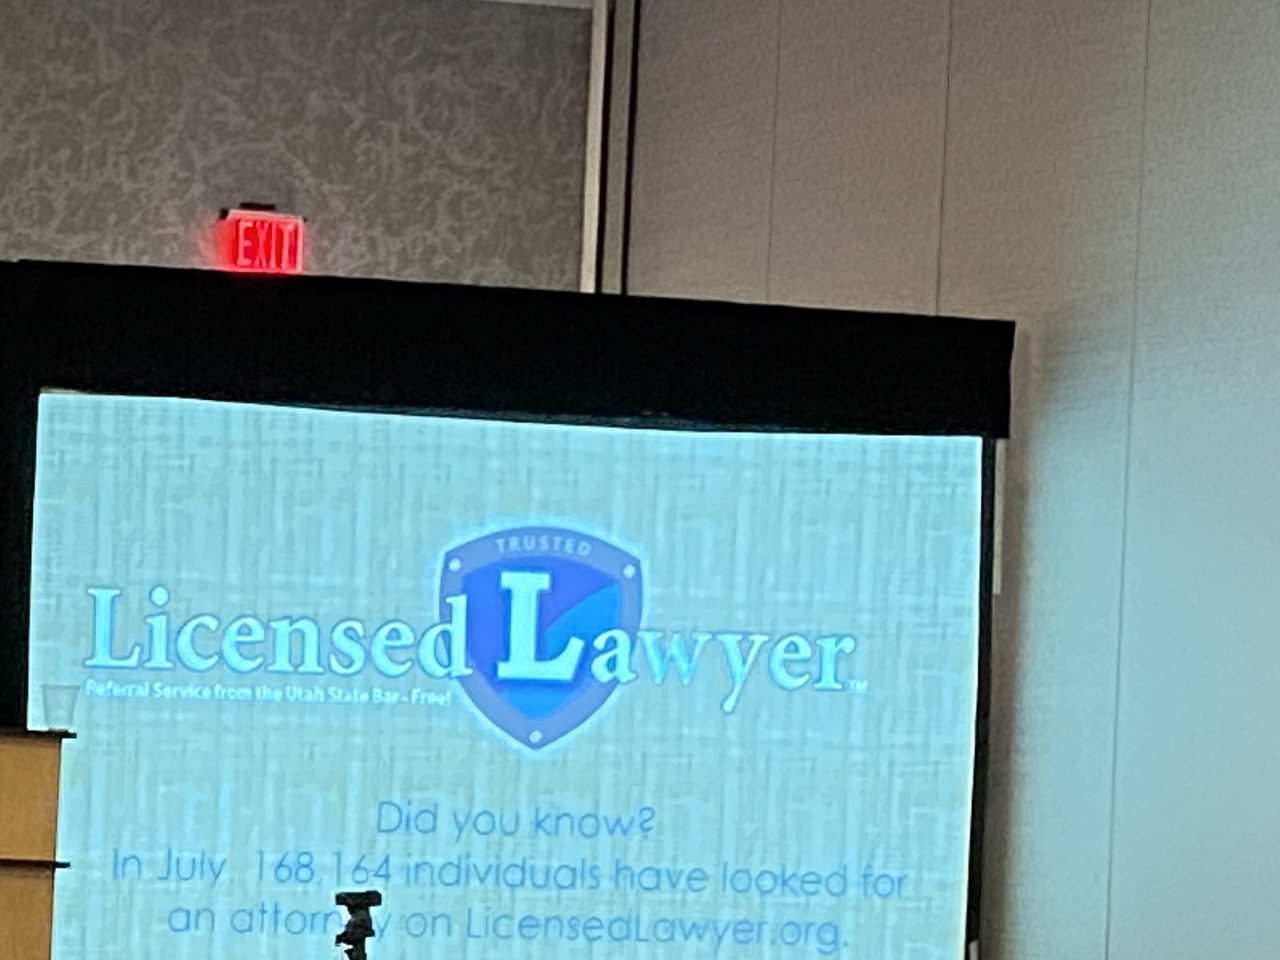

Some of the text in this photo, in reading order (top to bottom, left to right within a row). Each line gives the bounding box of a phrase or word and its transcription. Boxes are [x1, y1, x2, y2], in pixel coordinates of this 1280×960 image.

[237, 220, 295, 269] EXIT
[495, 534, 592, 557] TRUSTED
[85, 679, 149, 698] Referral
[152, 682, 212, 700] Service
[214, 683, 252, 700] from
[255, 685, 283, 700] the
[285, 685, 325, 703] Utah
[327, 686, 370, 704] State
[372, 688, 400, 704] Bar
[377, 801, 656, 843] Did you know?
[112, 848, 910, 900] In July, 168,164 individuals have looked for
[167, 902, 851, 956] an attorny on LicensedLawyer.org.
